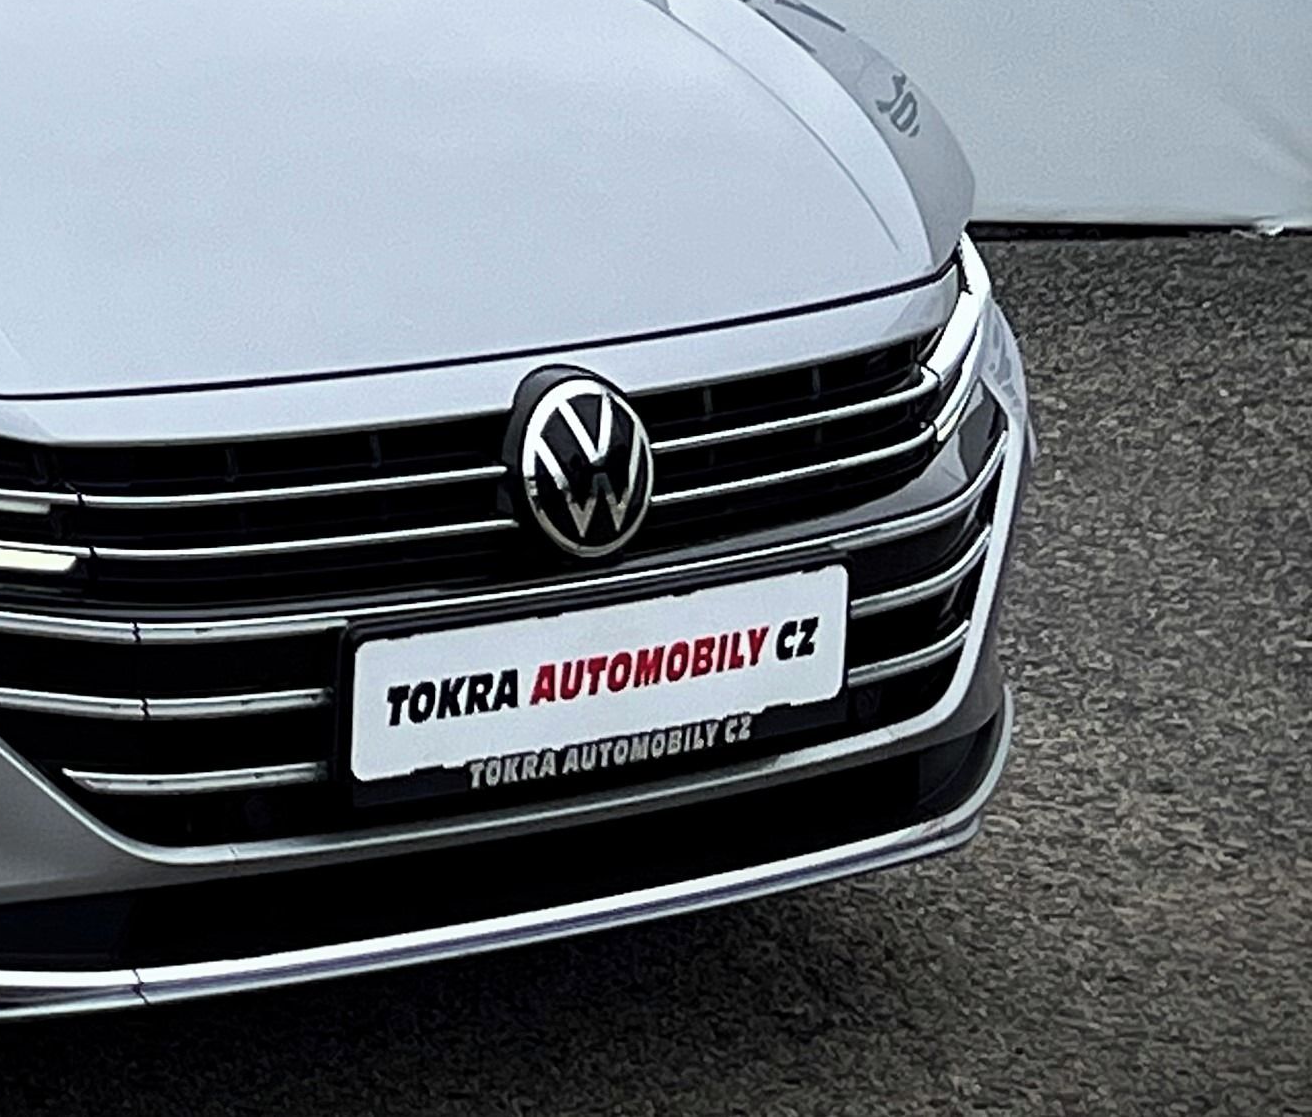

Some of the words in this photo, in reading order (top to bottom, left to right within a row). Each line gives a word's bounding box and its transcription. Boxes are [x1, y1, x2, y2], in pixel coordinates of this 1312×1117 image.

[387, 669, 518, 726] TOKRA
[530, 627, 769, 705] AUTOMOBILY
[776, 617, 818, 660] CZ
[470, 749, 556, 789] TOKRA
[562, 720, 718, 774] AUTOMOBILY
[724, 715, 751, 744] CZ
